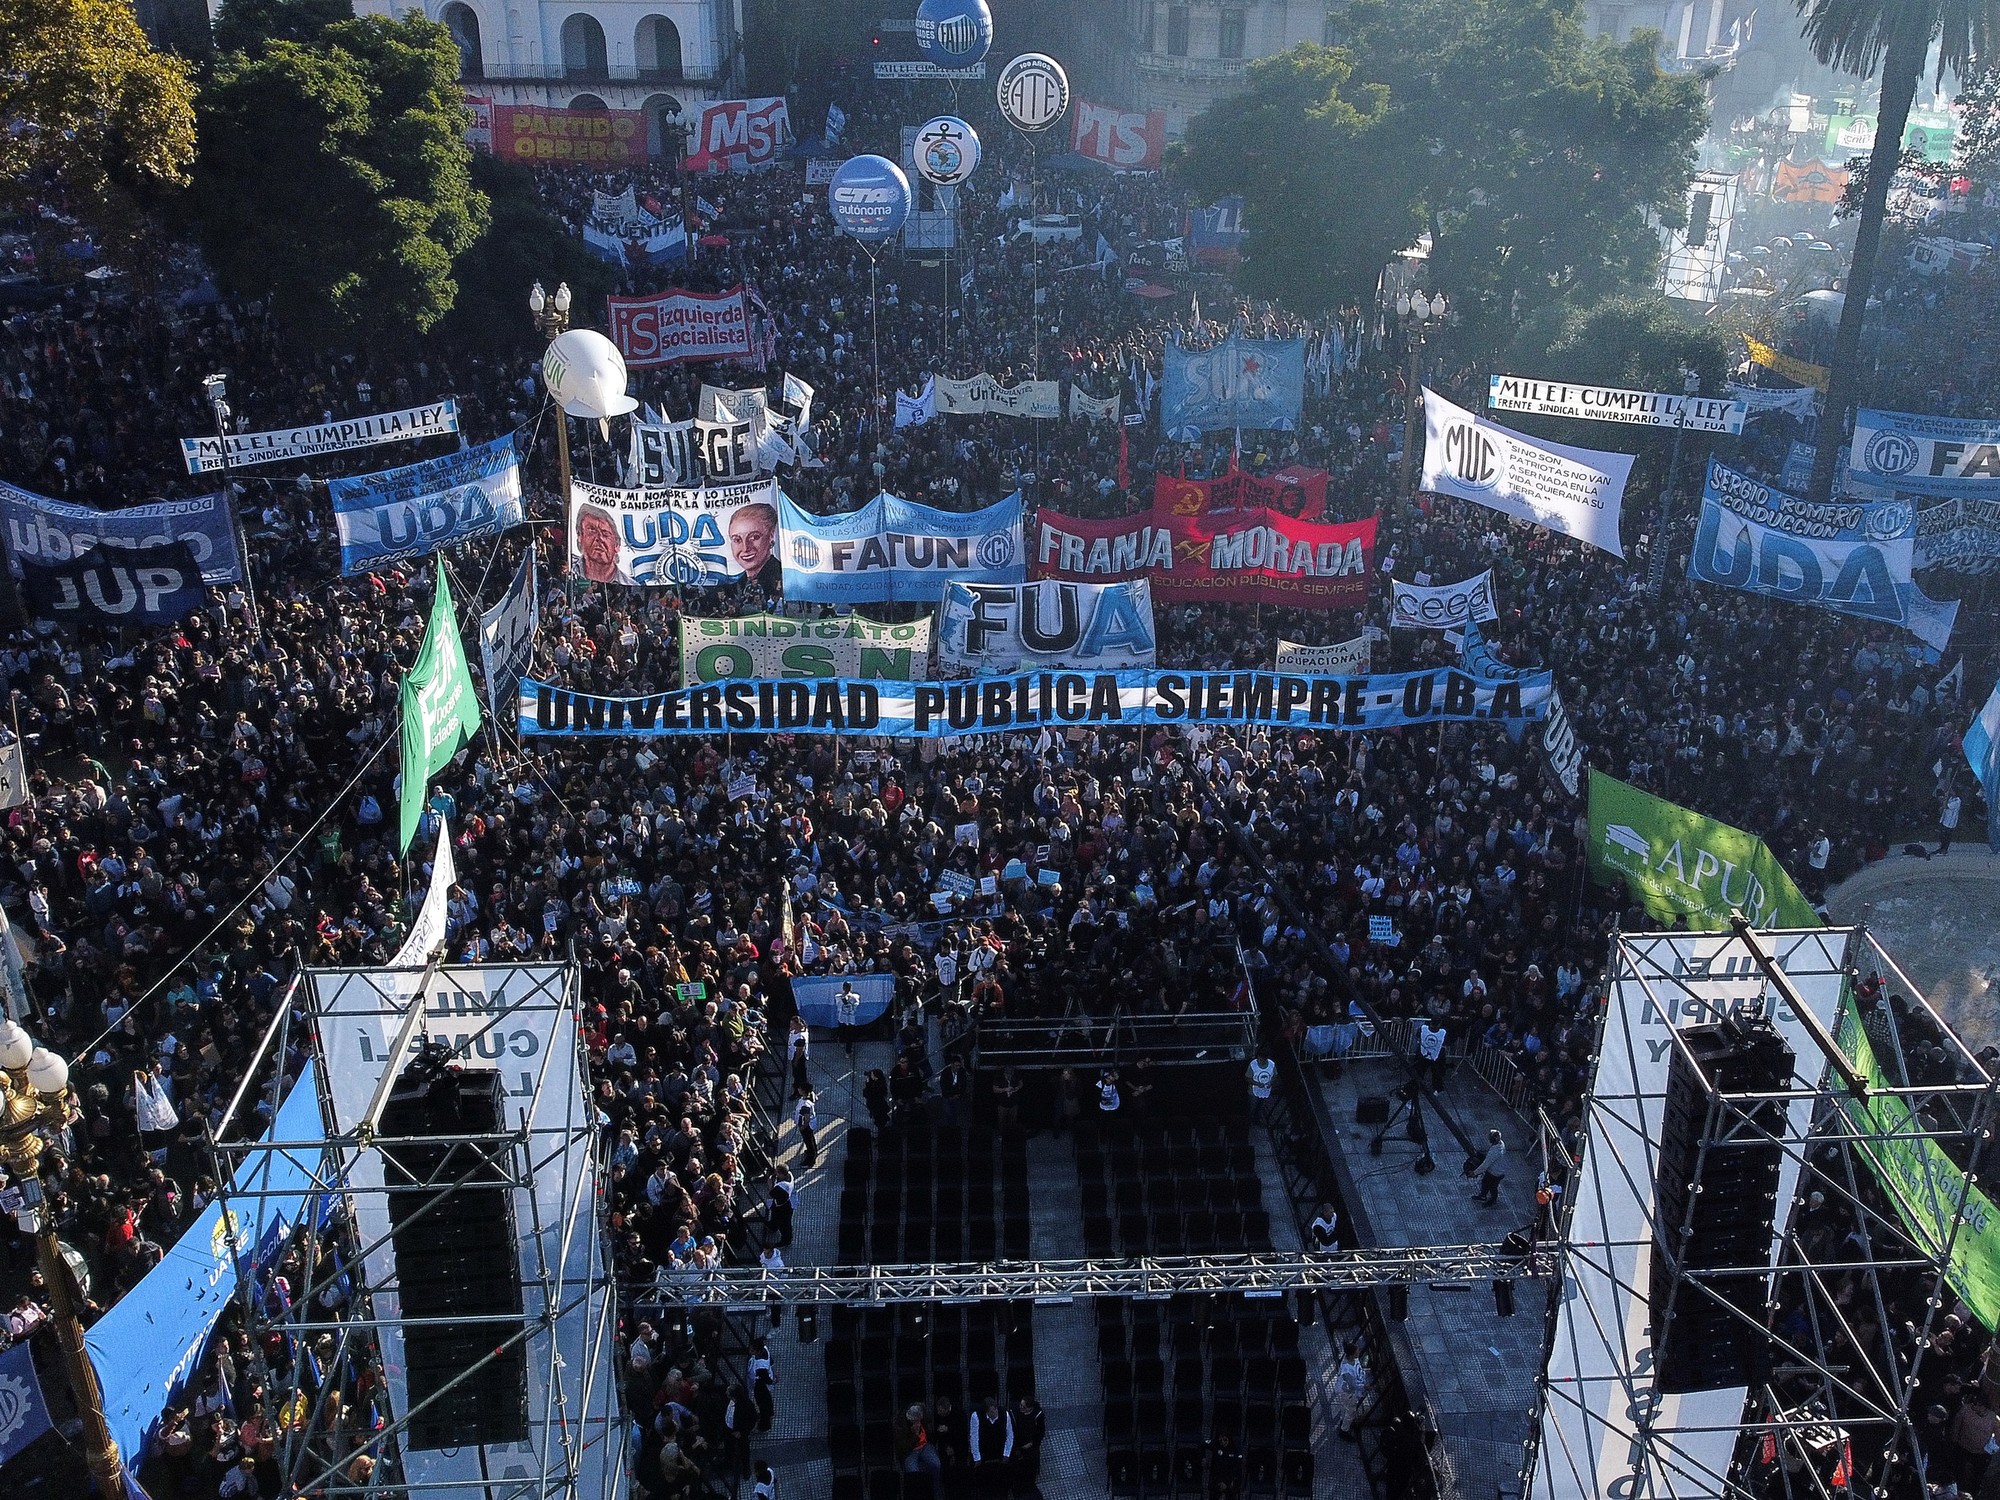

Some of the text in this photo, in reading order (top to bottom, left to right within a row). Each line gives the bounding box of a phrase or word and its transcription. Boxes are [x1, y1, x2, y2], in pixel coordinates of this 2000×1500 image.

[1011, 72, 1055, 120] ATE
[512, 113, 636, 139] PARTIDO
[709, 110, 788, 157] MST
[1075, 101, 1147, 163] PTS
[514, 137, 630, 161] OBRERO
[834, 187, 889, 203] CTA
[839, 204, 892, 215] autónoma
[660, 304, 743, 327] izquierda
[661, 325, 746, 348] socialista
[1498, 398, 1532, 411] FRENTE
[1538, 403, 1580, 416] SINDICAL
[1584, 408, 1661, 424] UNIVERSITARIO
[1703, 421, 1727, 432] FUA
[1581, 388, 1657, 414] CUMPLI
[1694, 400, 1732, 421] LEY
[290, 418, 371, 444] CUMPLI
[380, 413, 402, 435] LA
[410, 405, 443, 428] LEY
[248, 445, 296, 462] SINDICAL
[641, 423, 753, 482] SURGE
[1446, 423, 1496, 483] MUC
[1521, 447, 1537, 459] NO
[1509, 454, 1612, 486] PATRIOTAS NO VAN
[1509, 464, 1599, 496] A SER NADA EN LA
[589, 494, 751, 511] COMO BANDERA A LA VICTORIA
[626, 491, 639, 501] MI
[644, 490, 688, 501] NOMBRE
[692, 491, 700, 501] Y
[705, 490, 718, 500] LO
[723, 480, 772, 498] LLEVARAN
[1535, 480, 1581, 503] QUIERAN
[1581, 495, 1590, 507] A
[1588, 498, 1605, 510] SU
[1710, 461, 1770, 505] SERGIO
[1779, 493, 1863, 531] ROMERO
[375, 484, 499, 551] UDA
[622, 511, 725, 549] UDA
[817, 528, 830, 537] DE
[831, 527, 848, 537] LAS
[916, 522, 979, 533] NACIONALES
[909, 509, 928, 520] DEL
[1720, 494, 1840, 540] CONDUCCION
[351, 548, 419, 572] SERGIO
[831, 532, 969, 571] FATUN
[1038, 522, 1365, 577] FRANJA MORADA
[1694, 501, 1905, 623] UDA
[1302, 581, 1365, 595] SIEMPRE
[699, 619, 917, 641] SINDICATO
[966, 584, 1154, 658] FUA
[1278, 652, 1364, 667] OCUPACIONAL
[537, 682, 880, 732] UNIVERSIDAD
[914, 673, 1123, 732] PUBLICA
[1156, 673, 1370, 727] SIEMPRE
[1603, 851, 1651, 887] Asociación
[1649, 876, 1664, 891] del
[1665, 884, 1706, 913] Personal
[1704, 905, 1719, 920] de
